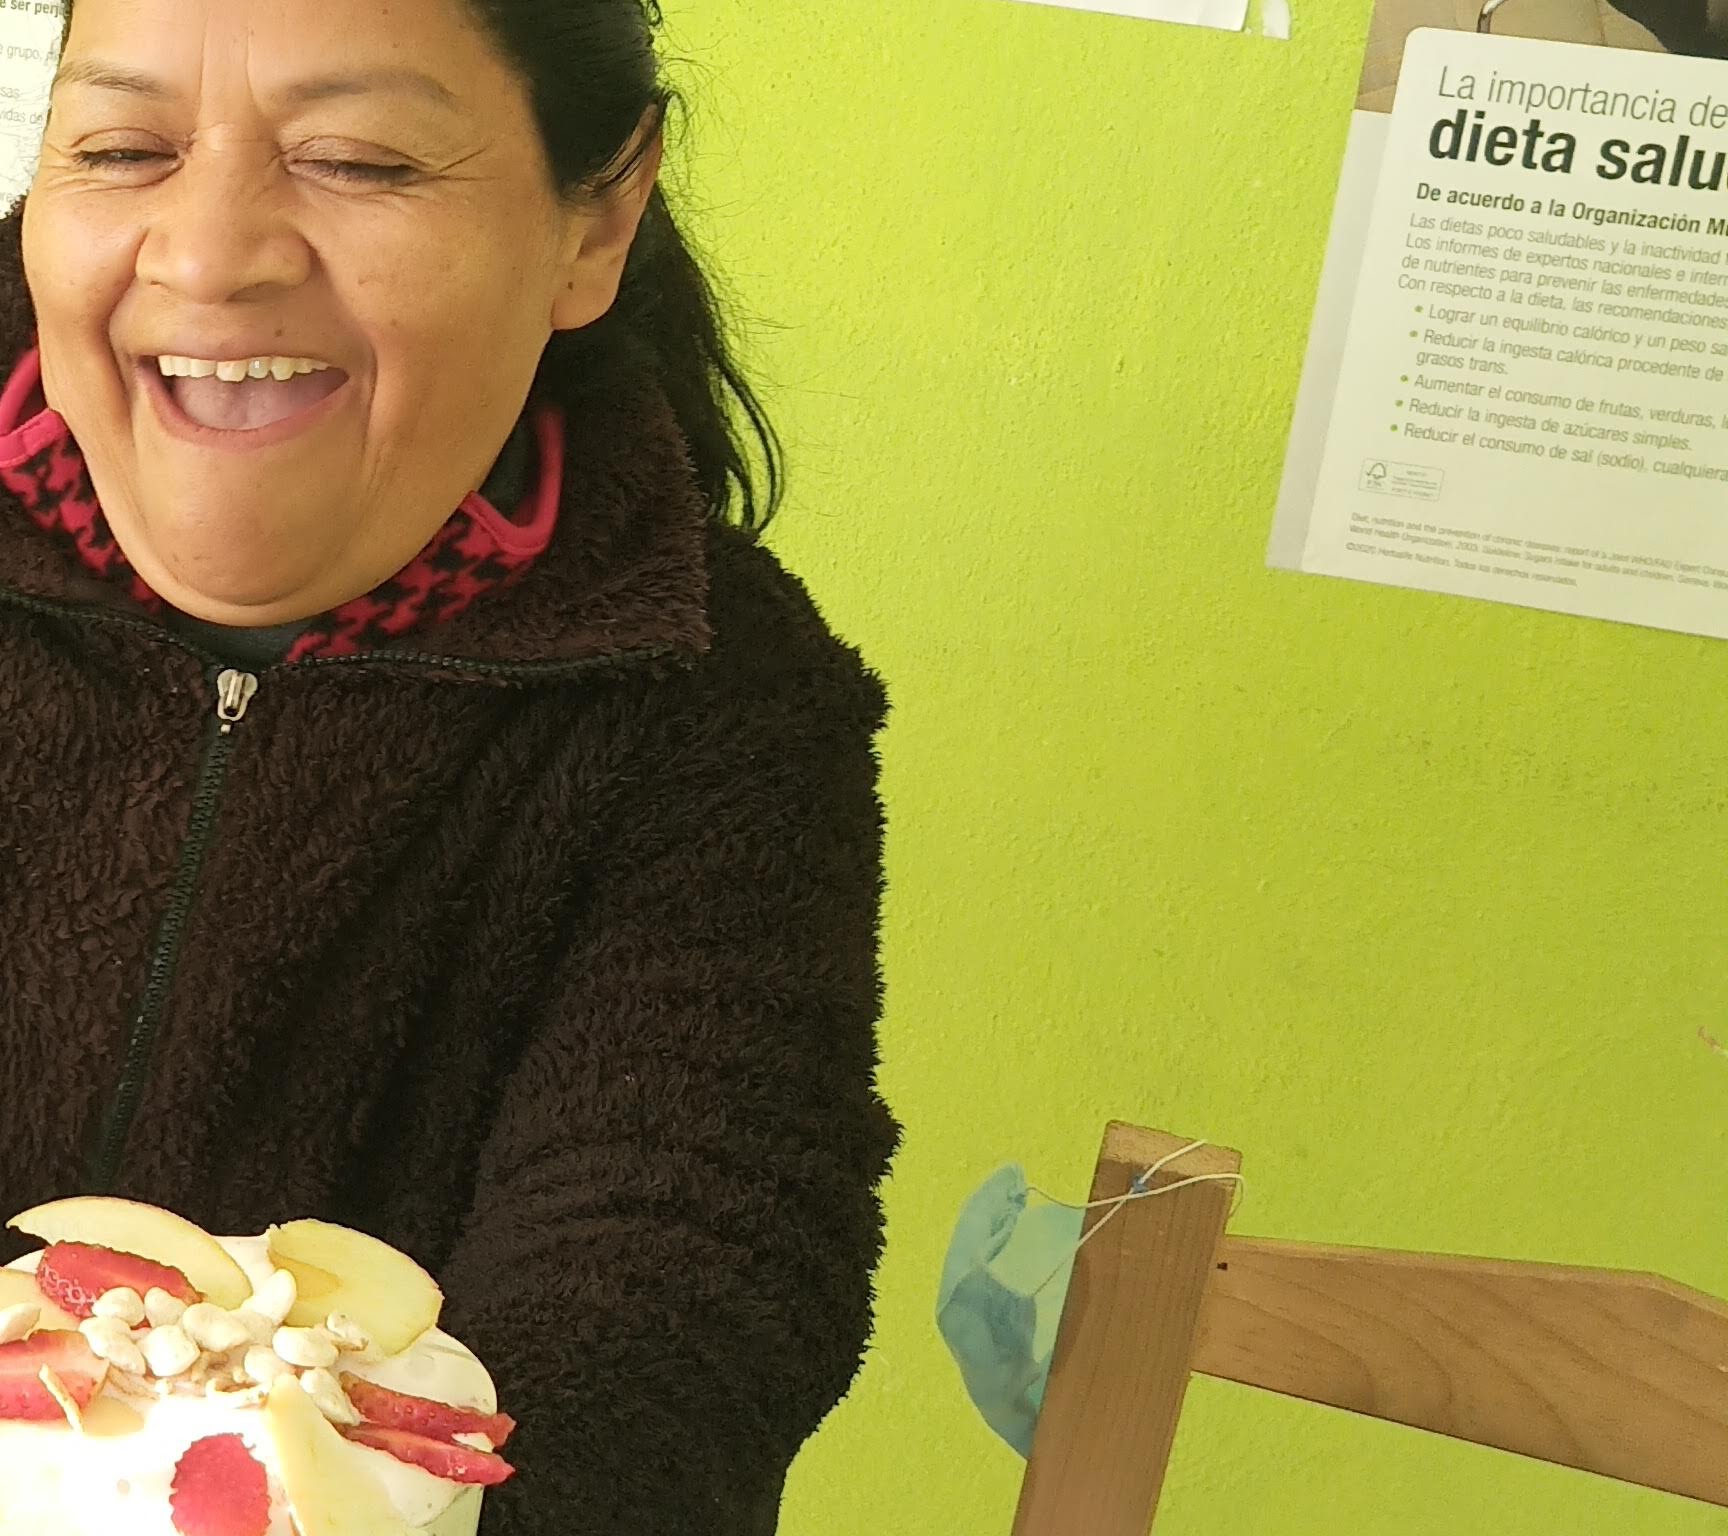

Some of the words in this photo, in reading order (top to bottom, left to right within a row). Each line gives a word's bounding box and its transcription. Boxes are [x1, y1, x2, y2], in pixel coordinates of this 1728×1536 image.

[1438, 65, 1476, 100] La
[1488, 71, 1677, 123] importancia
[1688, 95, 1728, 129] de
[1429, 109, 1576, 174] dieta
[1596, 134, 1728, 191] salu
[1416, 182, 1441, 201] De
[1446, 190, 1524, 211] acuerdo
[1530, 200, 1542, 214] a
[1548, 198, 1565, 217] la
[1572, 202, 1700, 232] Organización
